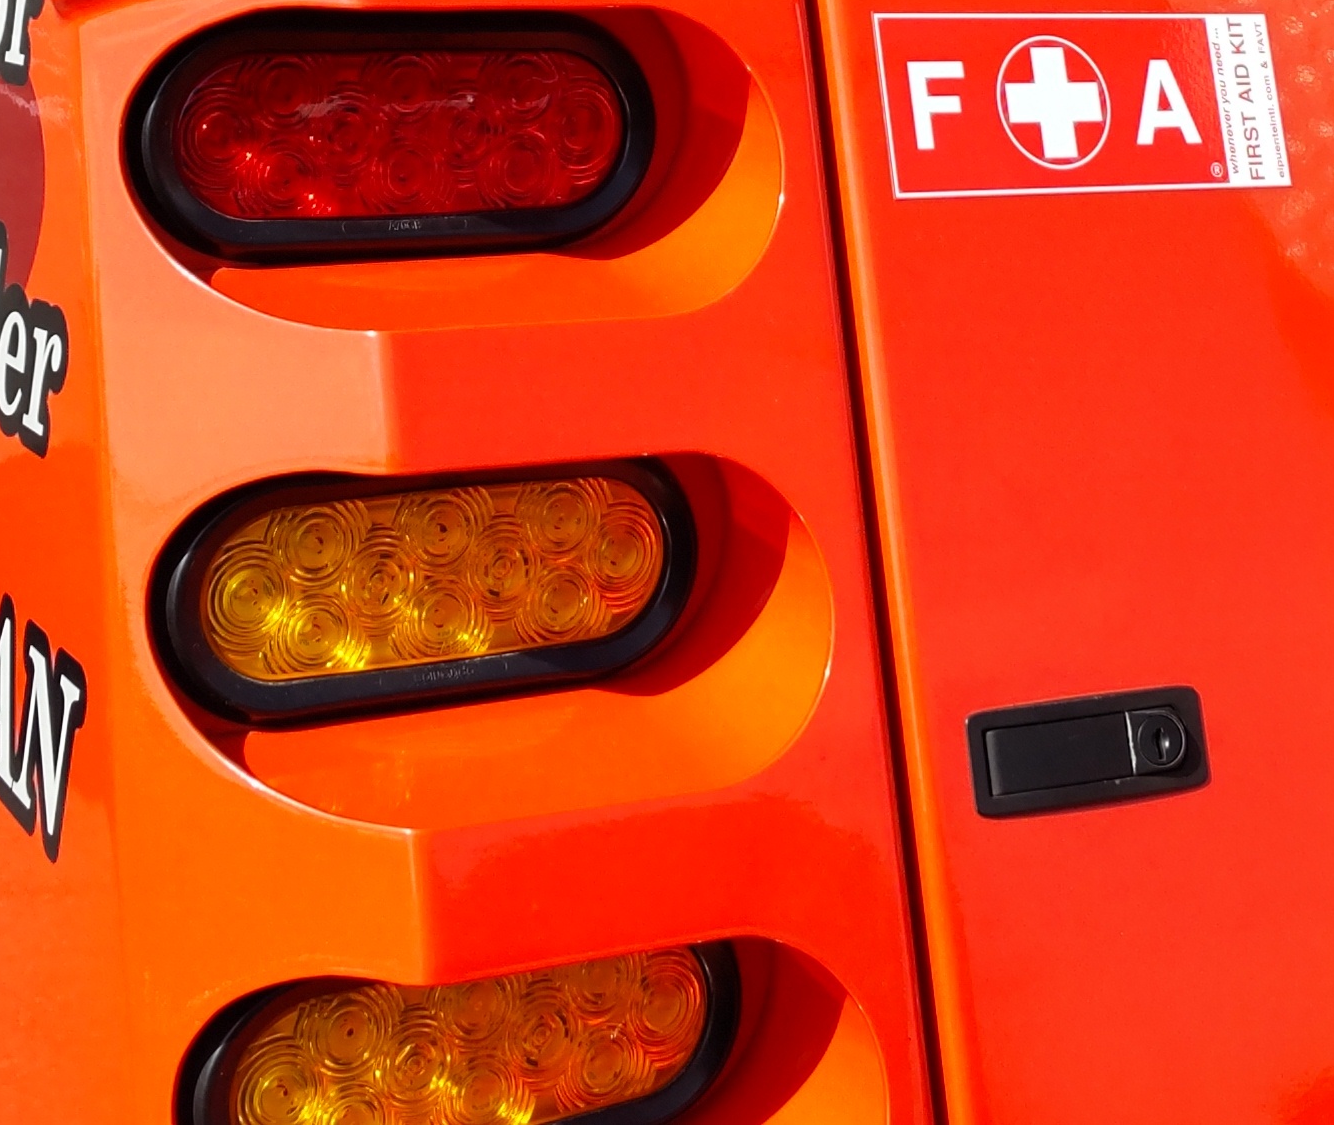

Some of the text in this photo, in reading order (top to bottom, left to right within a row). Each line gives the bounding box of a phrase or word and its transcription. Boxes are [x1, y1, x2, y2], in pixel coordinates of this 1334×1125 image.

[906, 59, 1202, 150] F A
[1219, 80, 1231, 104] you
[1226, 17, 1265, 181] FIRST AID KIT
